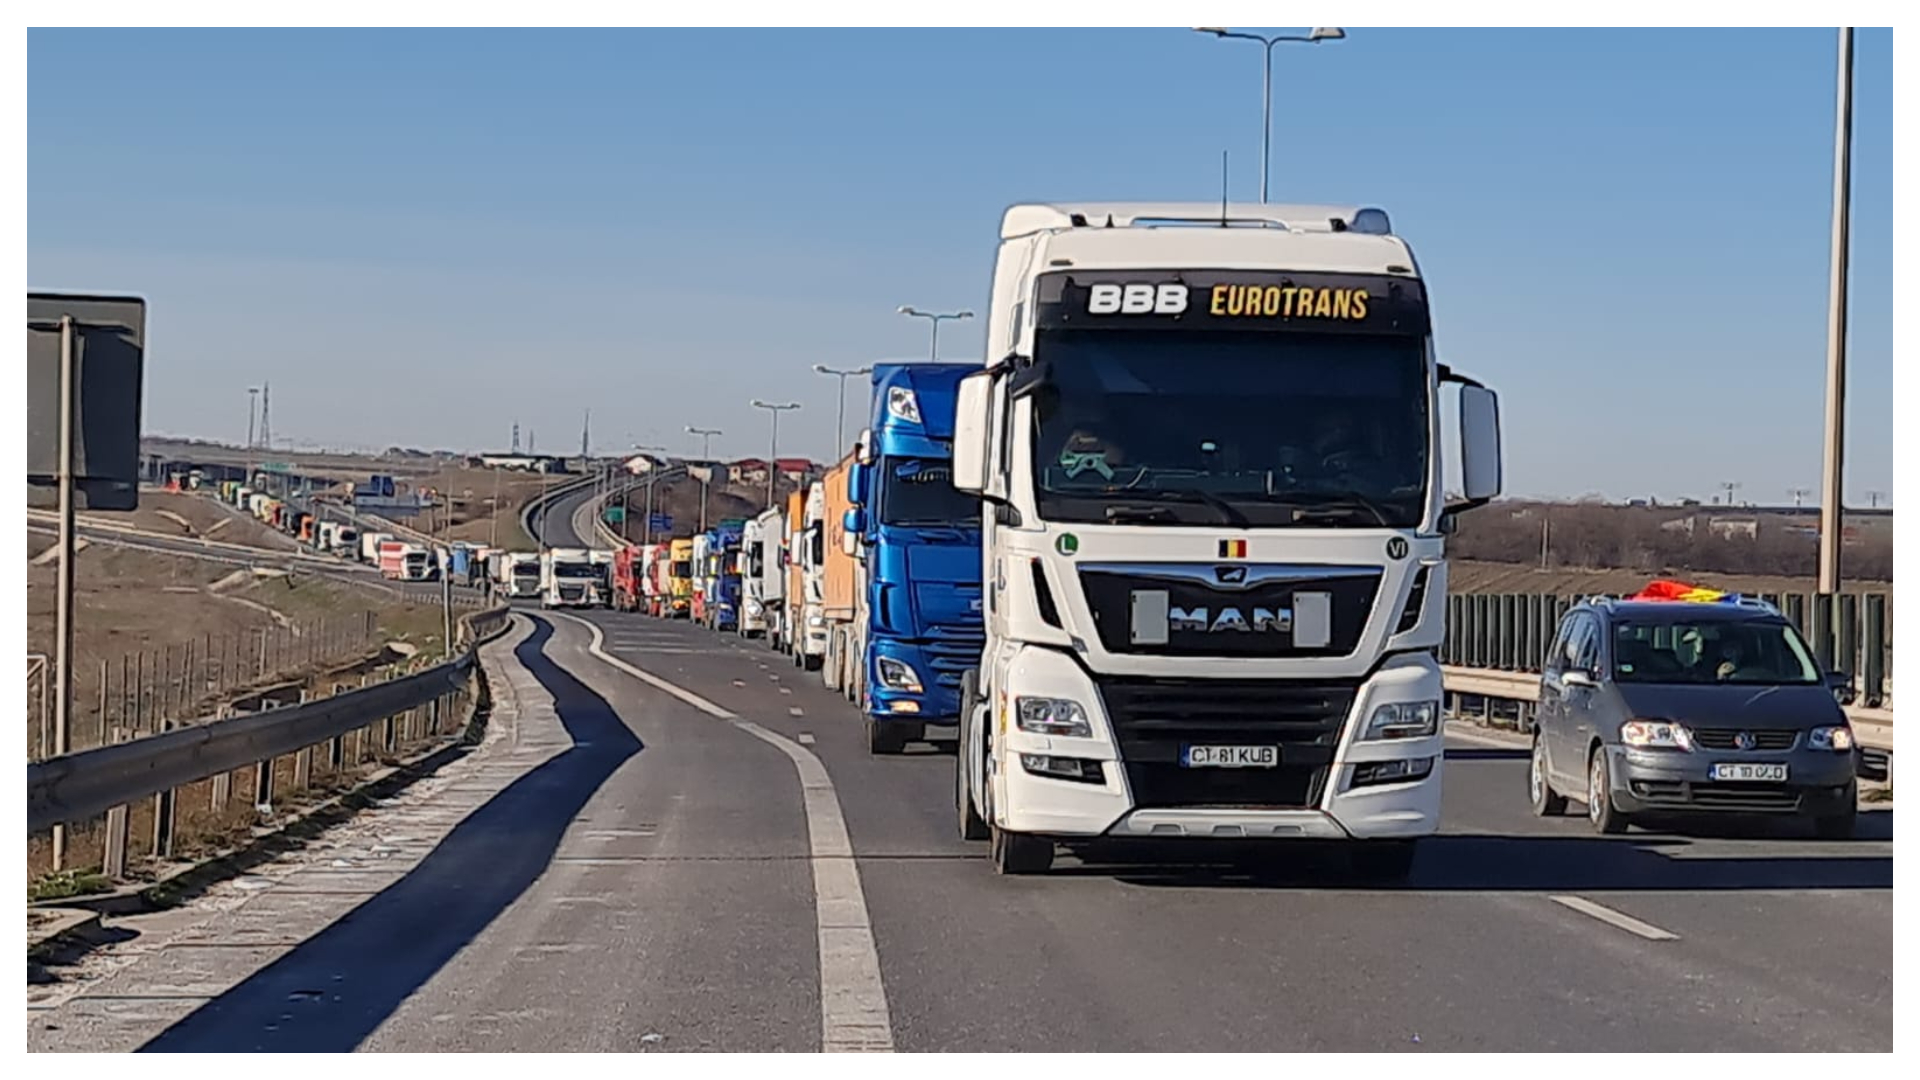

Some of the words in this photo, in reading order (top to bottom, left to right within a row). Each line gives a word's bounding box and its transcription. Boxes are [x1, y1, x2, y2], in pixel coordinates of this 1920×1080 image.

[1088, 284, 1189, 314] BBB
[1210, 284, 1368, 319] EUROTRANS
[1169, 606, 1293, 633] MAN
